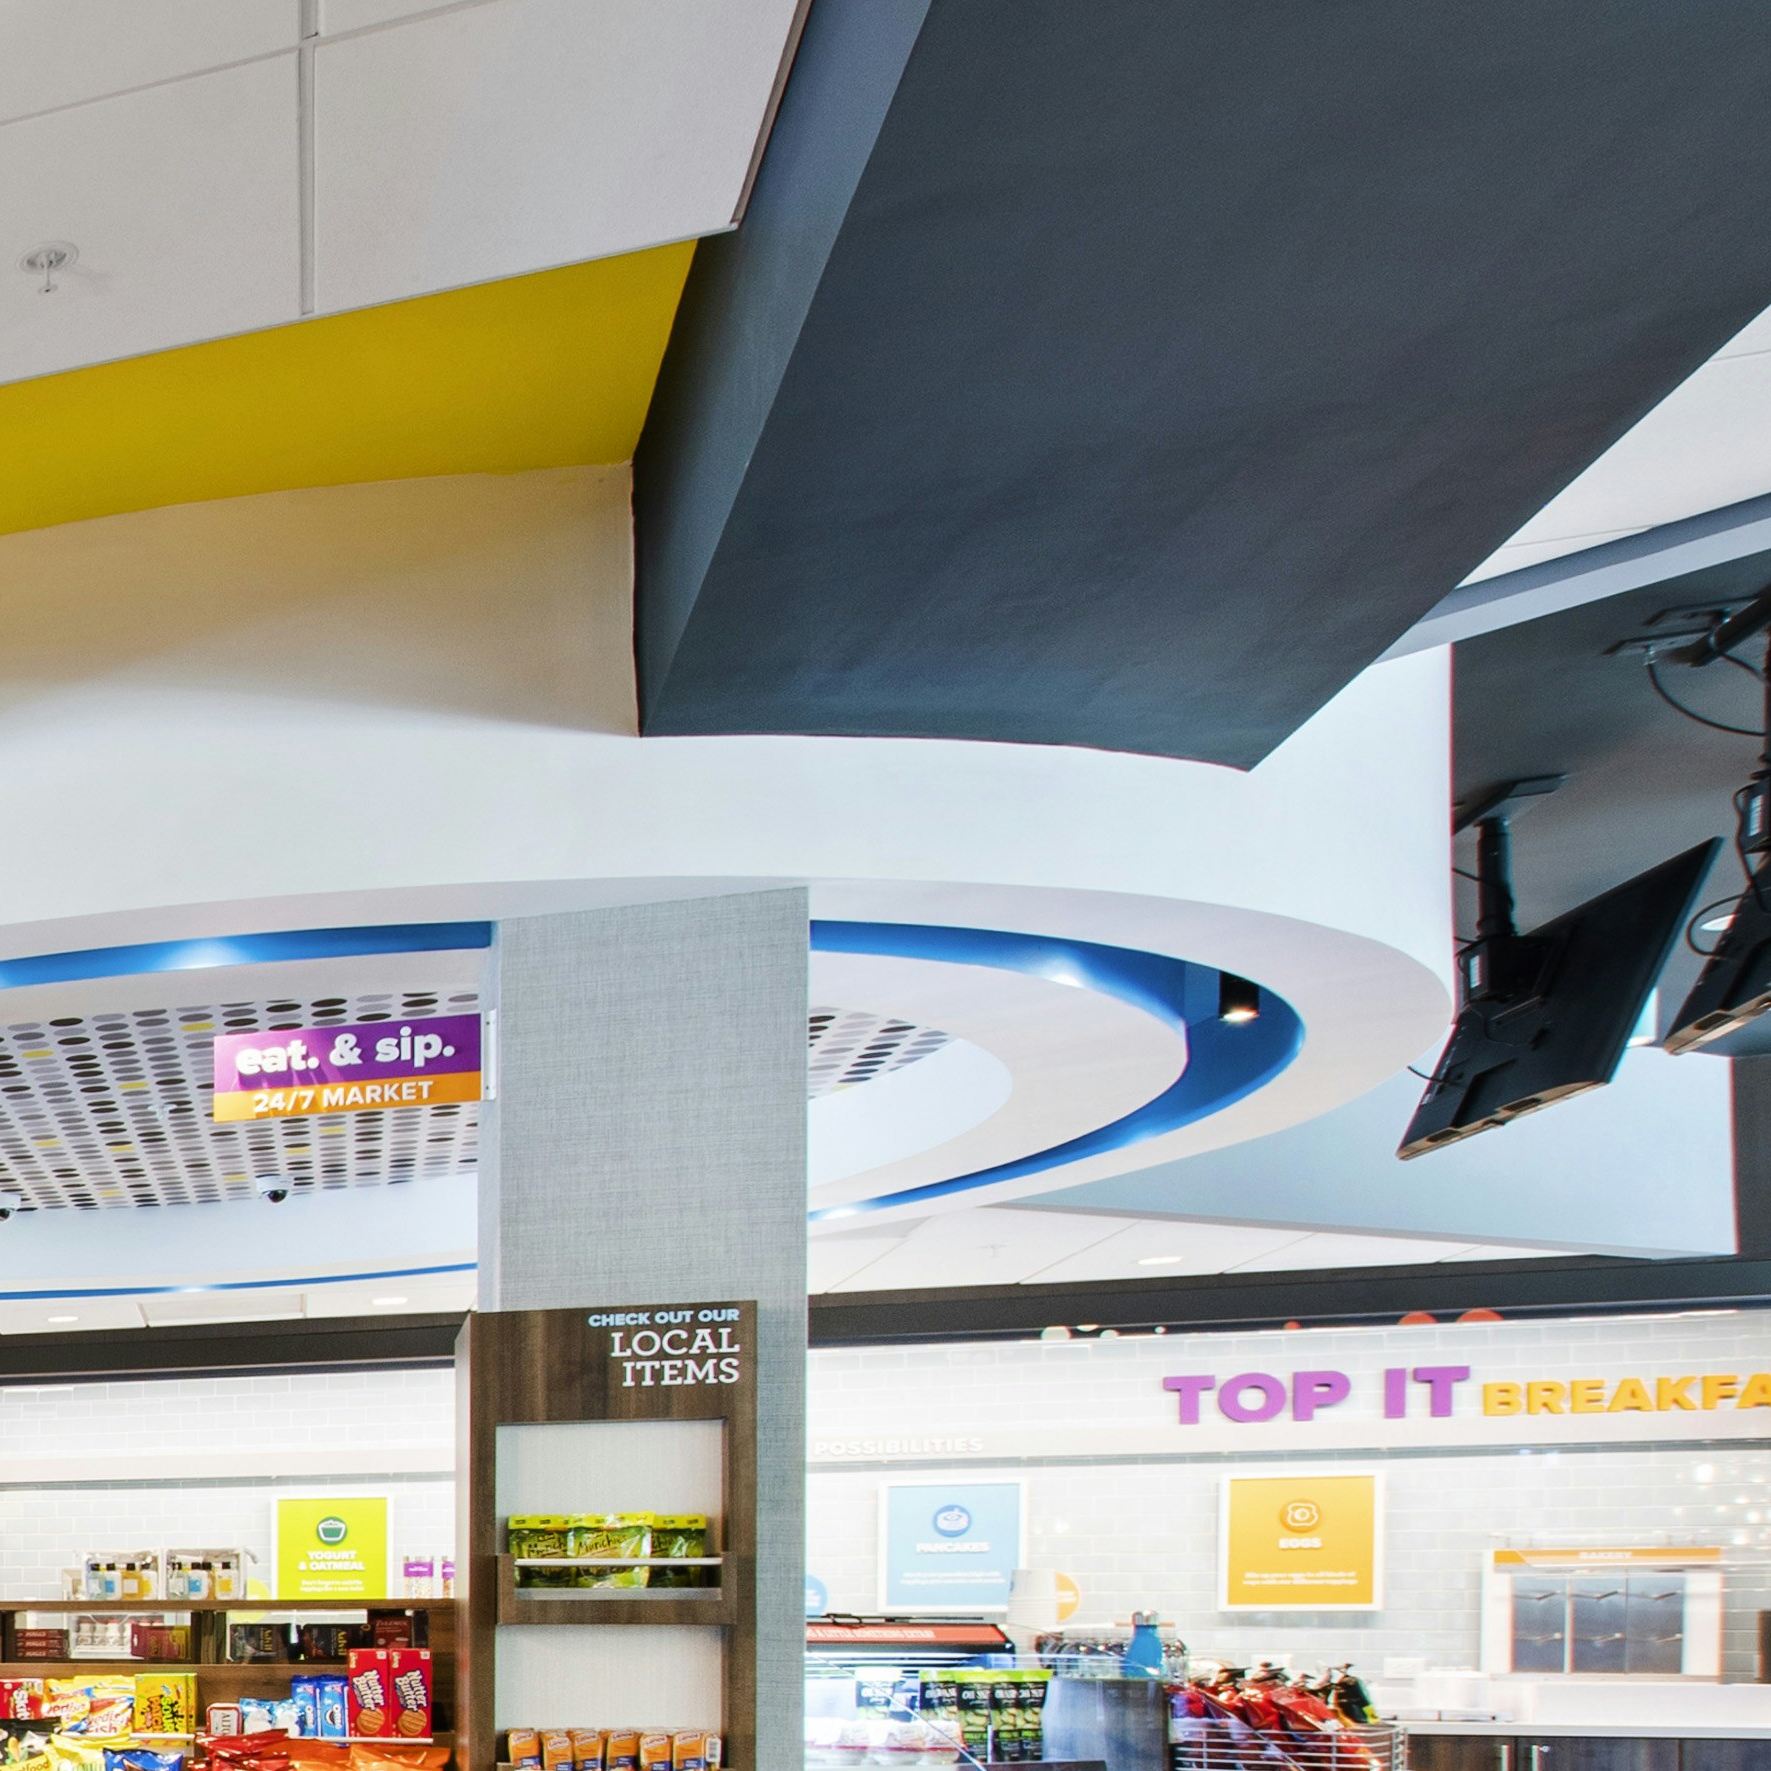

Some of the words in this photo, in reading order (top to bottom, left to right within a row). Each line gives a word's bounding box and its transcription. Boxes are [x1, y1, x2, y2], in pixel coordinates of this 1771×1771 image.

[235, 1039, 320, 1075] eat.
[330, 1033, 363, 1066] &
[375, 1026, 455, 1067] sip.
[254, 1090, 314, 1113] 24/7
[323, 1081, 433, 1107] MARKET
[588, 1312, 650, 1327] CHECK
[654, 1310, 694, 1324] OUT
[698, 1308, 740, 1322] OUR
[611, 1328, 740, 1357] LOCAL
[622, 1358, 740, 1387] ITEMS
[1162, 1370, 1352, 1425] TOP
[1384, 1365, 1471, 1419] IT
[814, 1438, 984, 1456] POSSIBILITIES
[307, 1551, 357, 1560] YOGURT
[310, 1561, 364, 1570] OATMEAL
[353, 1675, 376, 1711] Butter
[364, 1669, 385, 1706] Nutter
[395, 1676, 419, 1712] Butter
[406, 1669, 428, 1708] Nutter
